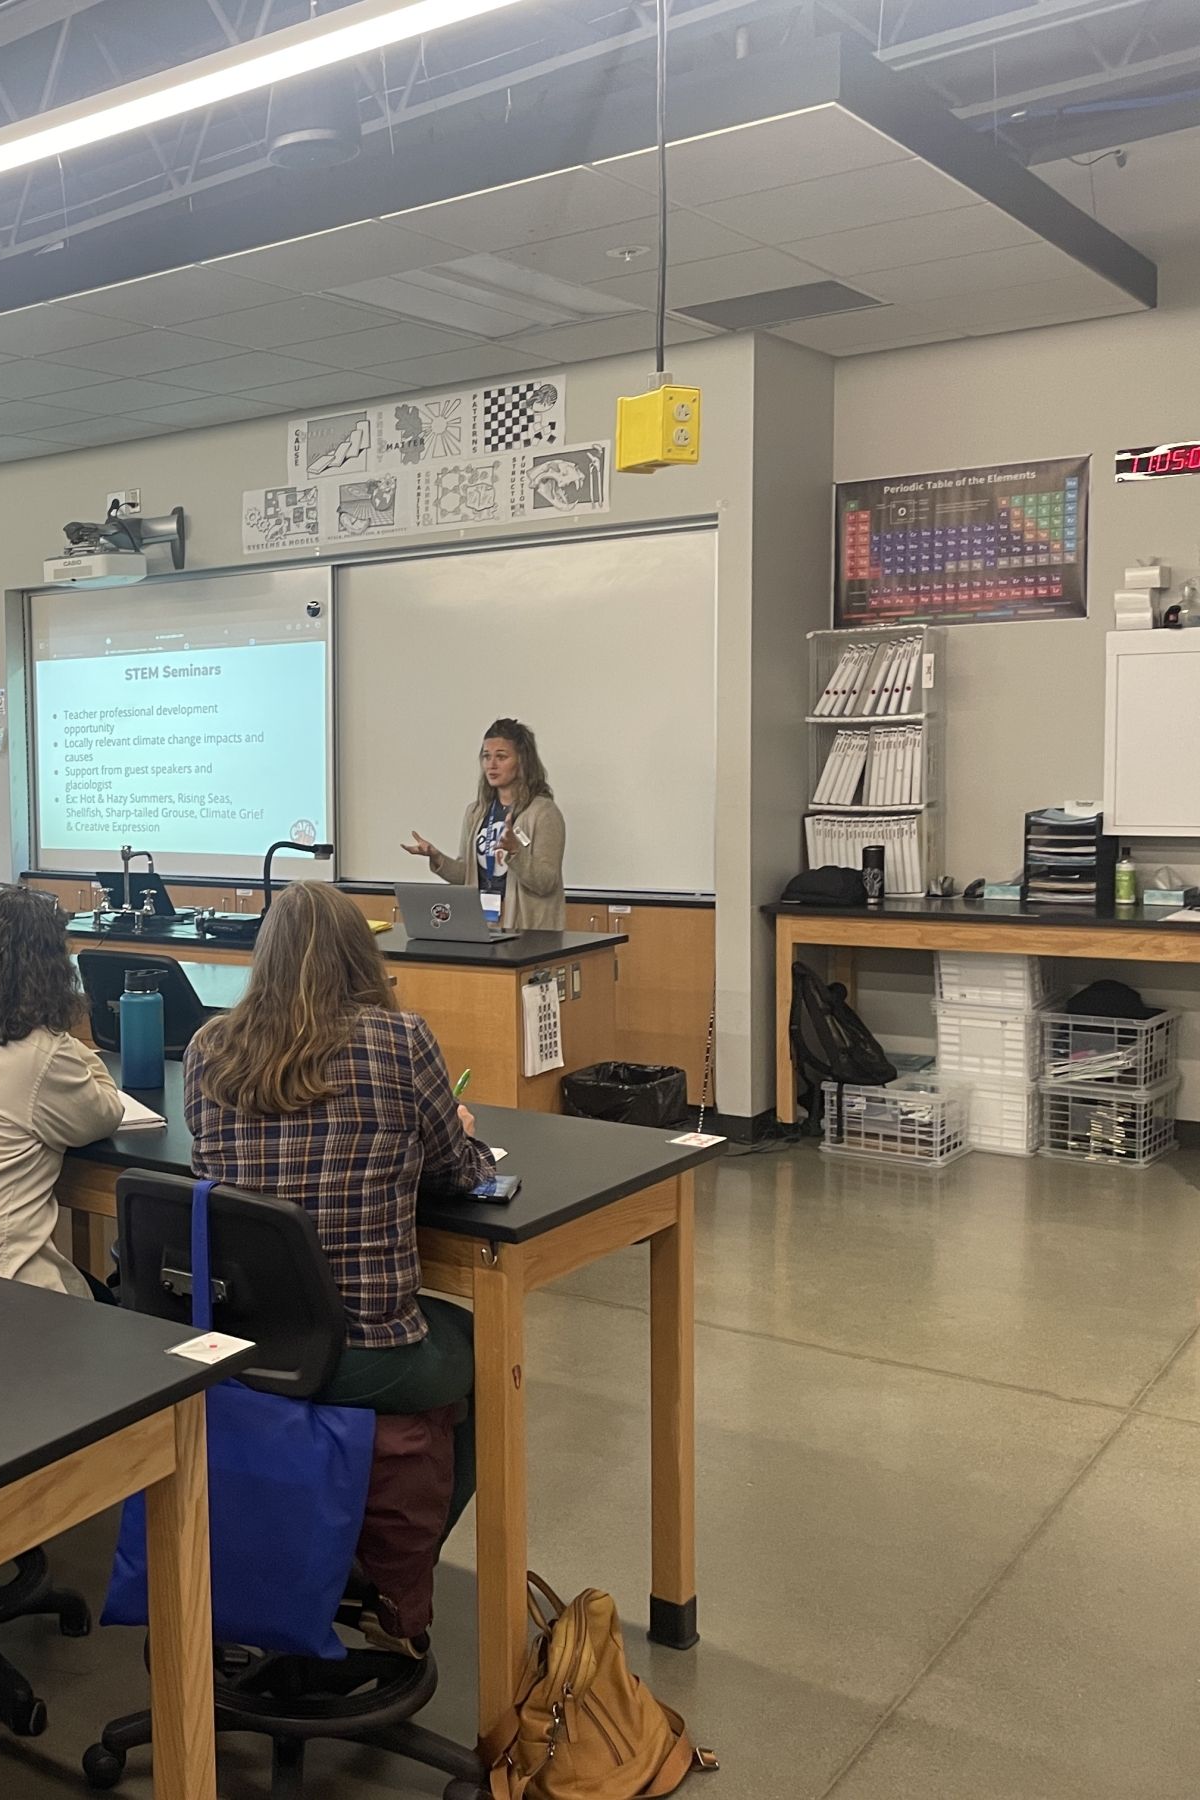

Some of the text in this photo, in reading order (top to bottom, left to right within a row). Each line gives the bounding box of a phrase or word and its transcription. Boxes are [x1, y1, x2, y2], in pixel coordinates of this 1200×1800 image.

[386, 437, 425, 450] MATTER
[883, 471, 1036, 495] Periodic Table of the Elements
[897, 507, 907, 516] O
[247, 541, 280, 551] SYSTEMS
[288, 536, 320, 547] MODELS
[124, 663, 222, 681] STEM Seminars
[64, 704, 219, 721] Teacher professional development
[64, 723, 115, 736] opportunity
[64, 731, 264, 750] Locally relevant climate change impacts and
[65, 753, 94, 762] causes
[65, 763, 213, 779] Support from guest speakers and
[65, 779, 113, 793] glaciologist
[80, 794, 96, 804] Hot
[97, 793, 105, 804] &
[106, 793, 128, 806] Hazy
[130, 792, 176, 804] Summers,
[178, 792, 206, 806] Rising
[207, 792, 233, 805] Seas,
[66, 806, 265, 821] Shellfish, Sharp-tailed Grouse, Climate Grief
[66, 821, 161, 834] & Creative Expression
